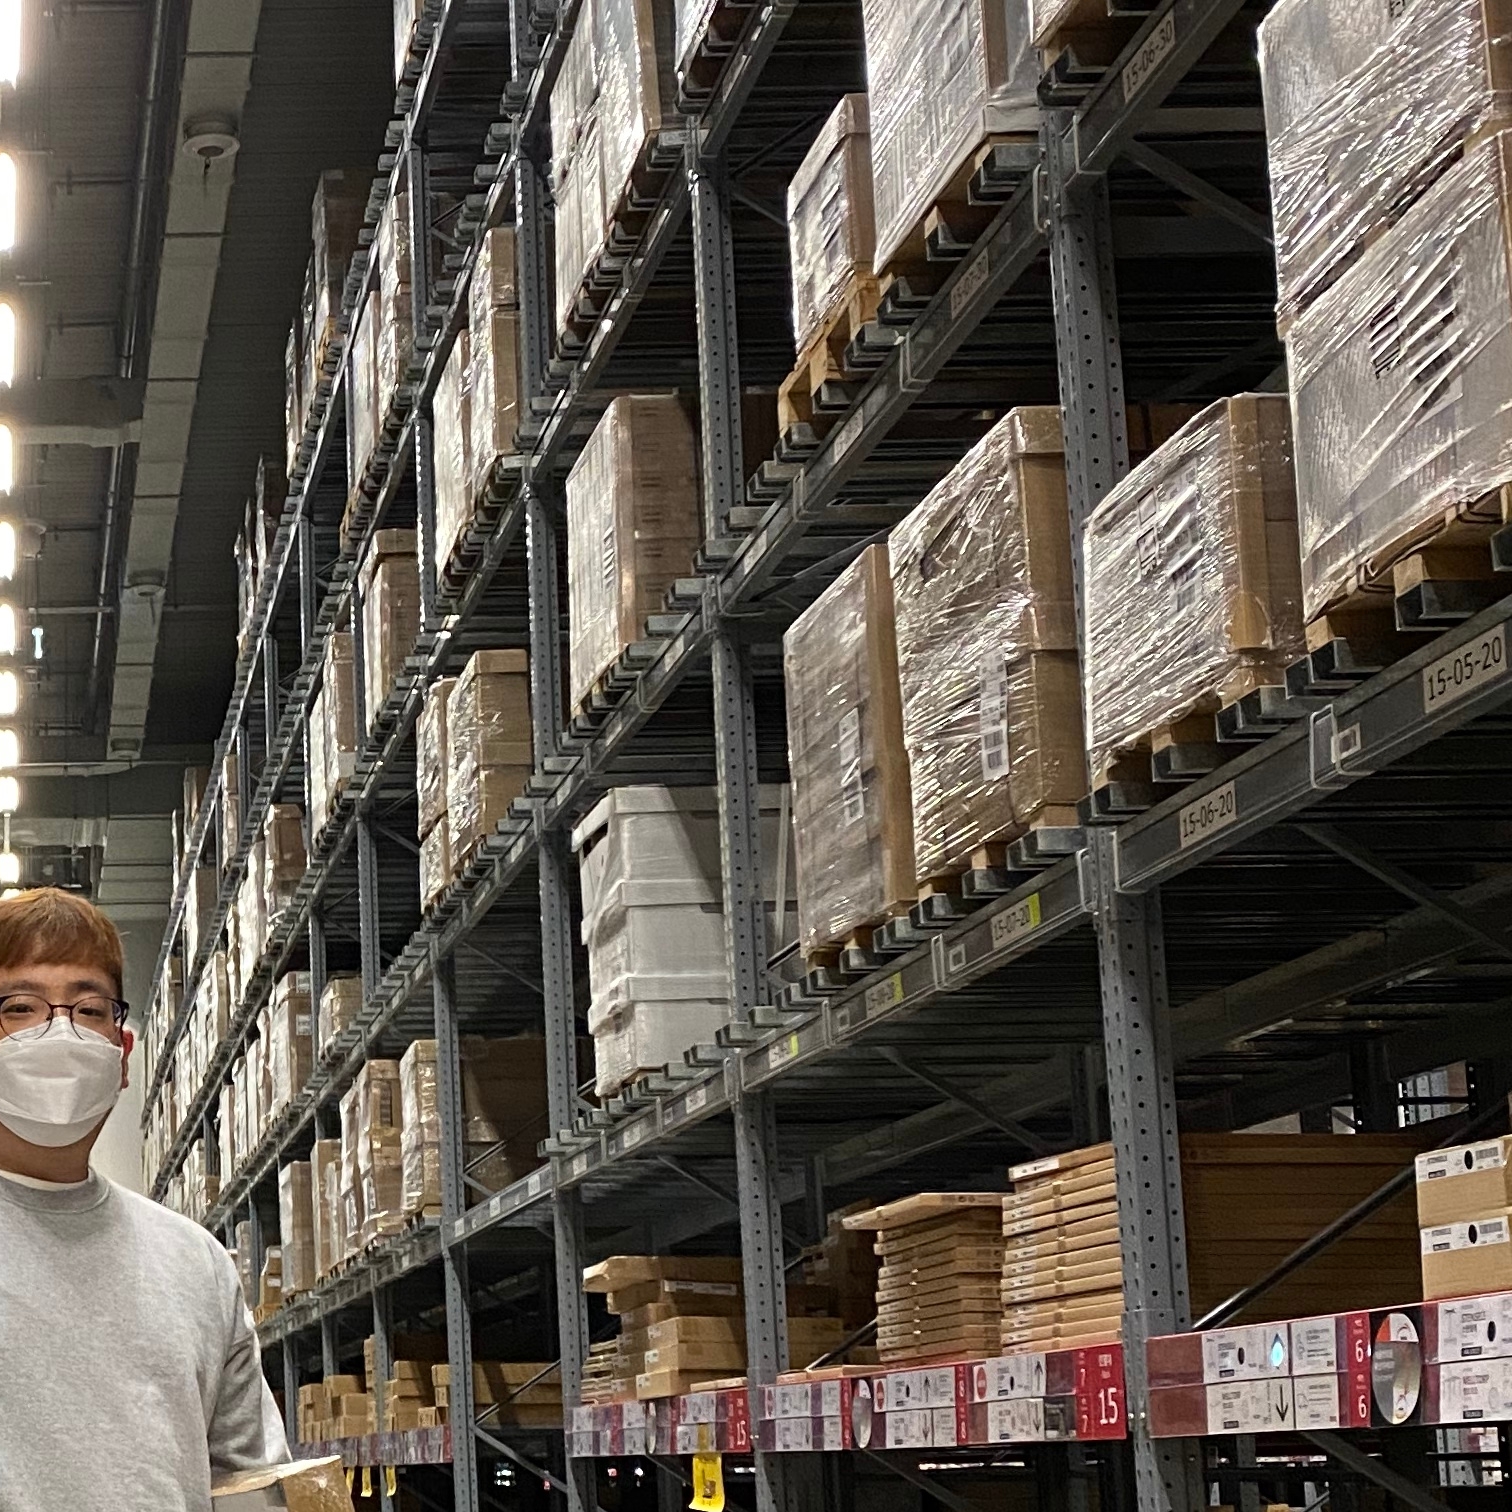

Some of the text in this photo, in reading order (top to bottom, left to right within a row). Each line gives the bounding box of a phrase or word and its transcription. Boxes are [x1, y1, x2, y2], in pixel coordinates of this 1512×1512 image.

[1126, 20, 1172, 93] 15-06-30
[1428, 636, 1502, 701] 15-05-20
[1183, 790, 1233, 838] 15-06-20
[1355, 1339, 1364, 1363] 6
[1080, 1368, 1087, 1387] 7
[1098, 1387, 1119, 1425] 15
[1358, 1395, 1367, 1418] 6
[736, 1420, 746, 1445] 15
[1082, 1414, 1088, 1433] 7
